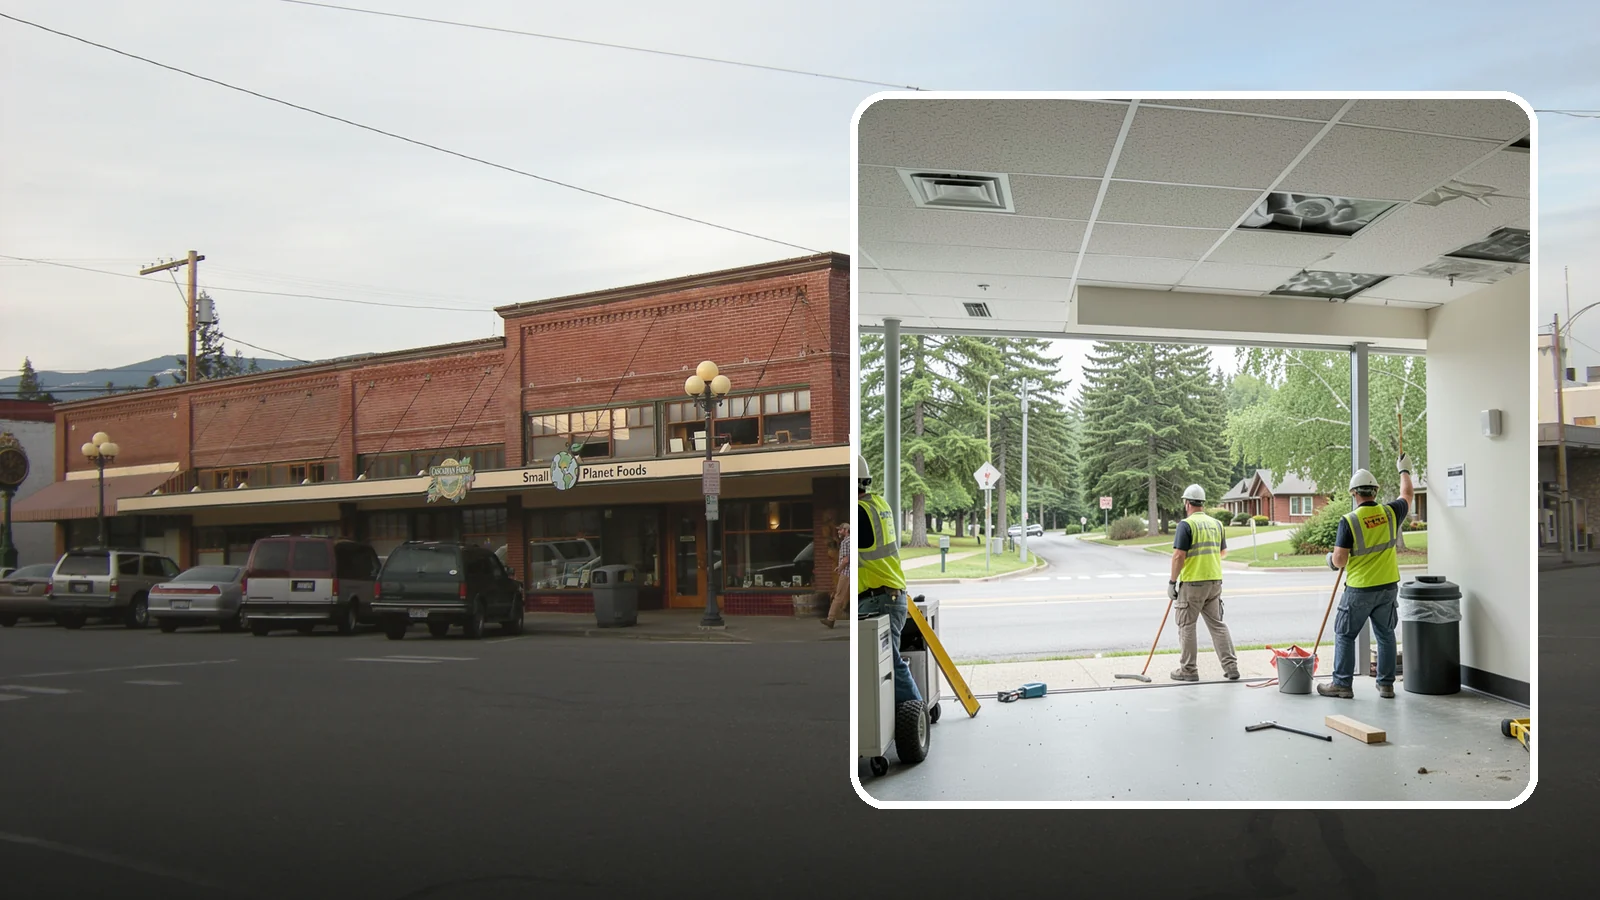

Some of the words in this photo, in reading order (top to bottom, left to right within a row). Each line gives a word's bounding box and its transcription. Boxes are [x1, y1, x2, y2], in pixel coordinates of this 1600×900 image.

[523, 471, 549, 482] Small
[583, 468, 614, 479] Planet
[617, 464, 647, 477] Foods
